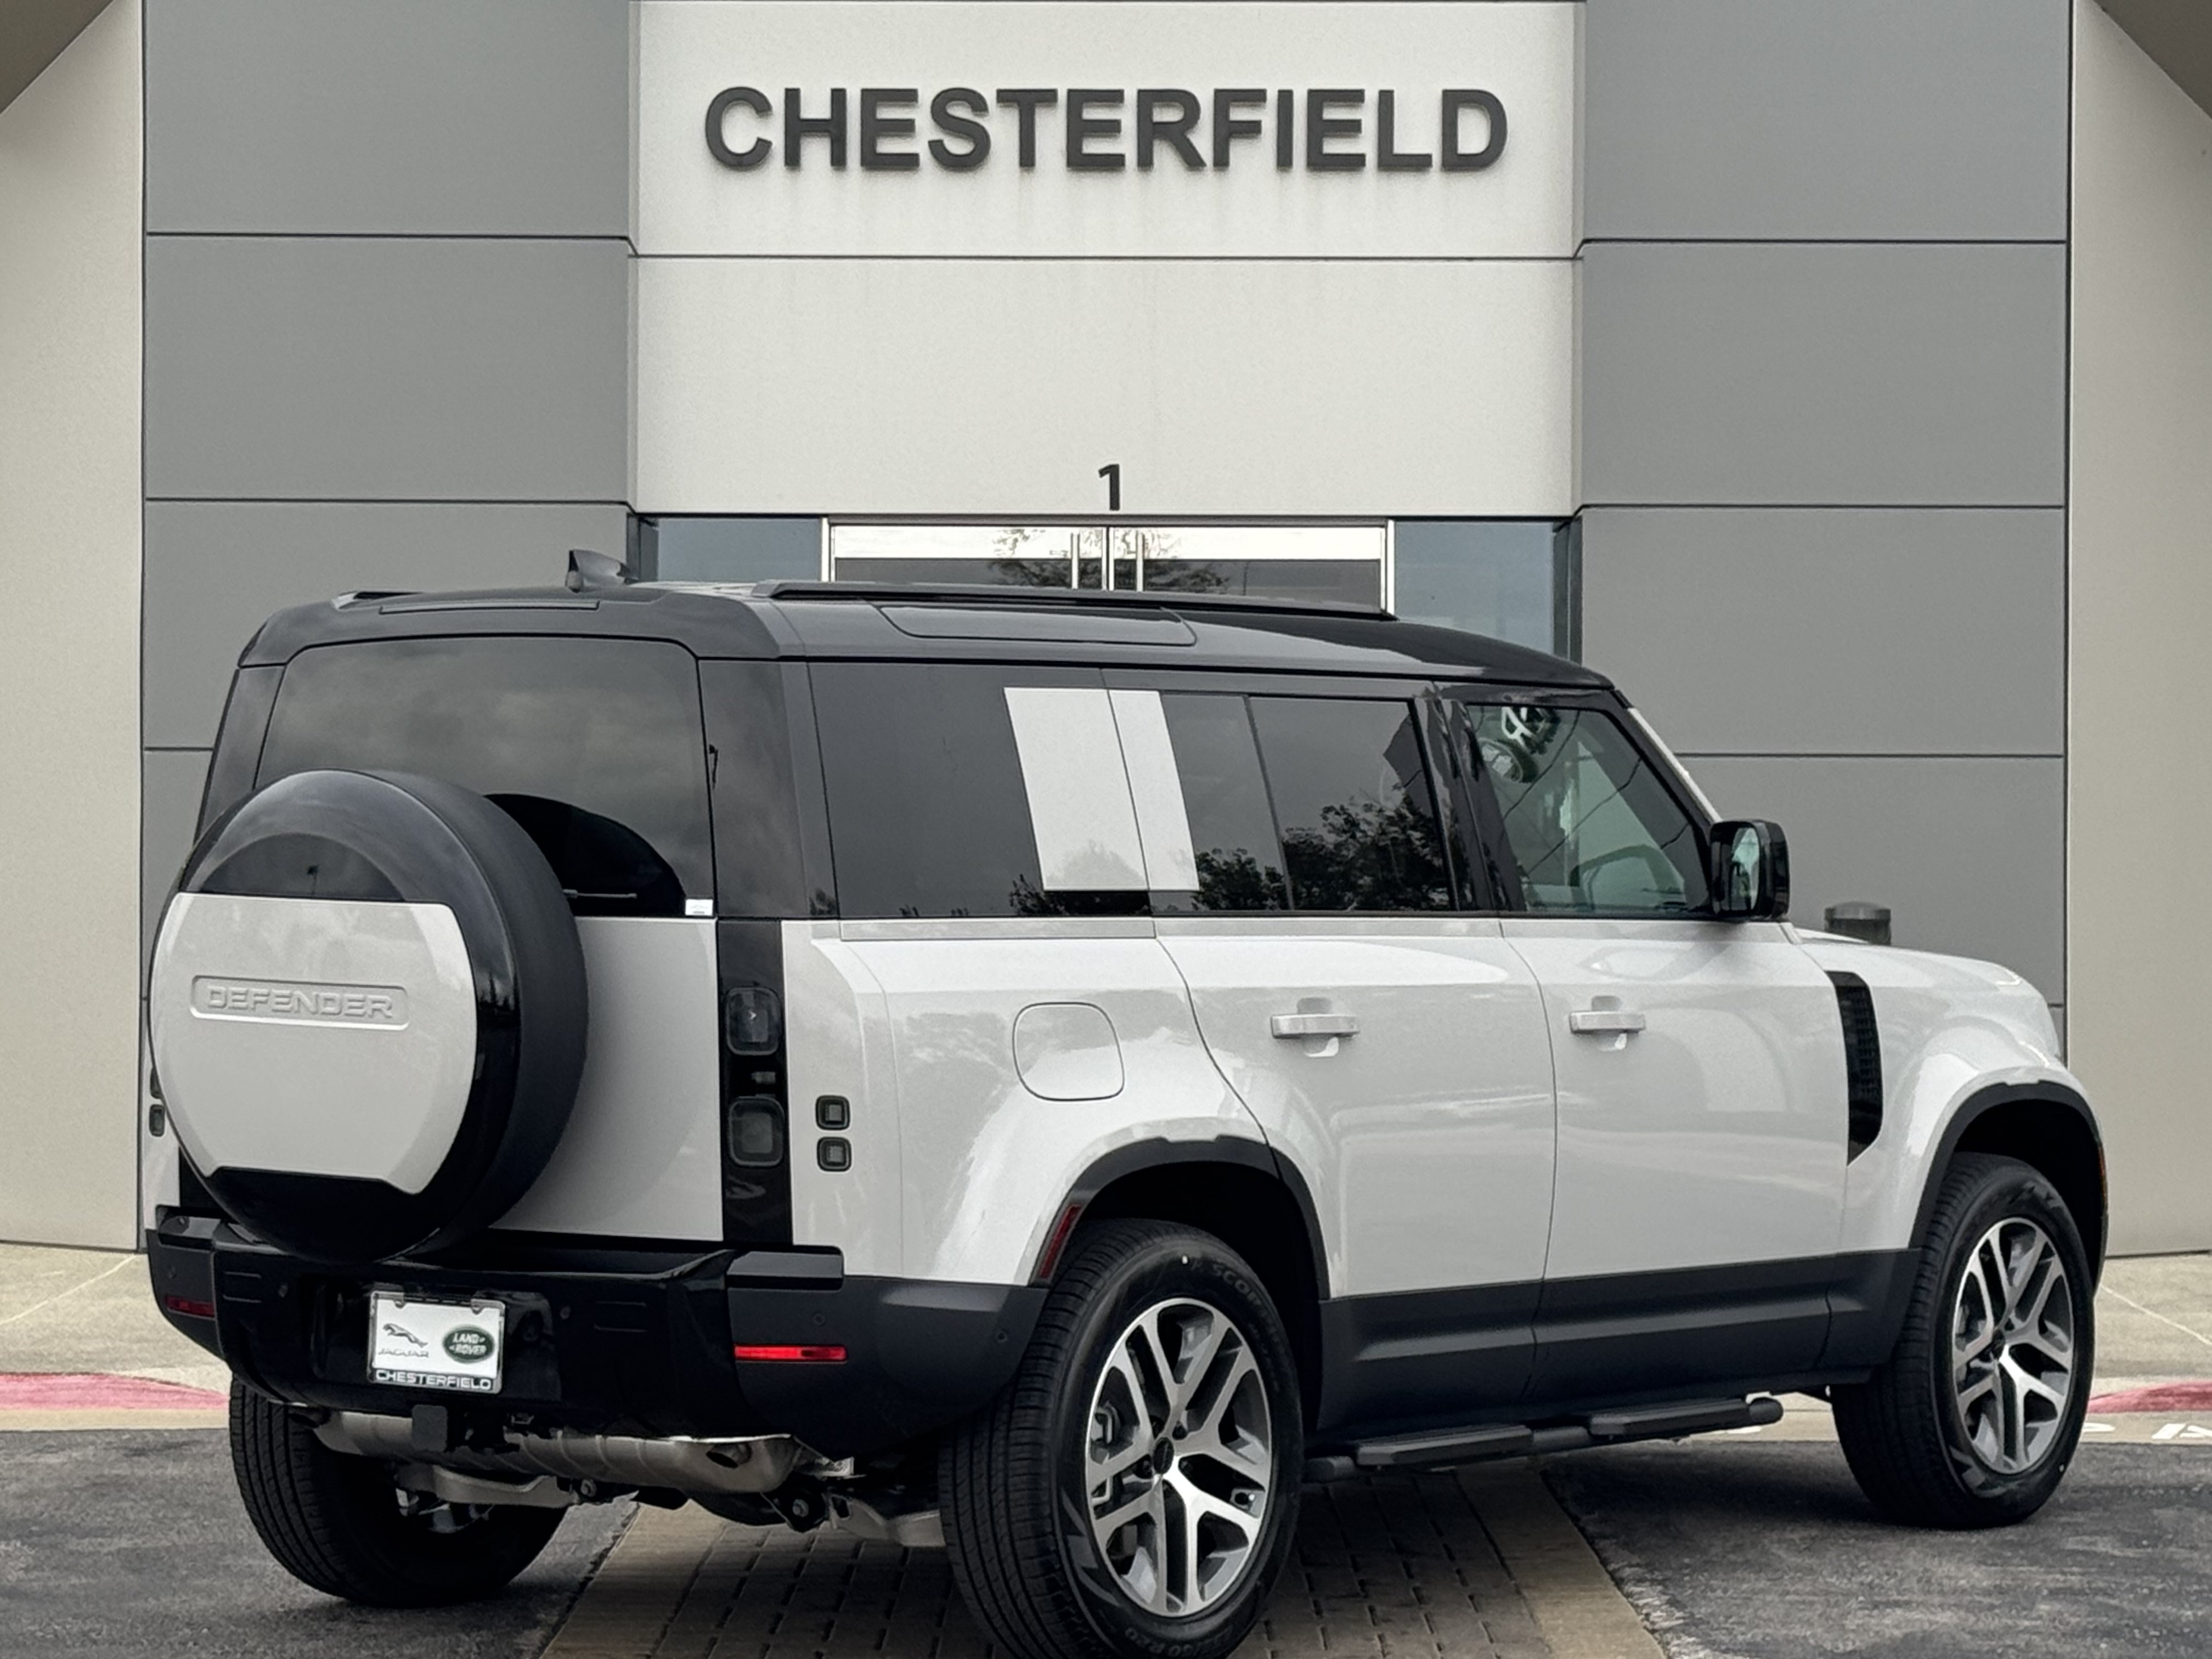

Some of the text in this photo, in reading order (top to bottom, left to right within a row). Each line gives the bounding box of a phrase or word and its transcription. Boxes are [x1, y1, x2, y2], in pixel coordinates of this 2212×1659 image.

[706, 87, 1506, 172] CHESTERFIELD
[1098, 464, 1120, 511] 1
[207, 985, 393, 1019] DEFENDER
[453, 1333, 478, 1344] LAND
[377, 1348, 429, 1358] JAGUAR
[455, 1345, 487, 1356] ROVER
[376, 1369, 492, 1391] CHESTERFIELD
